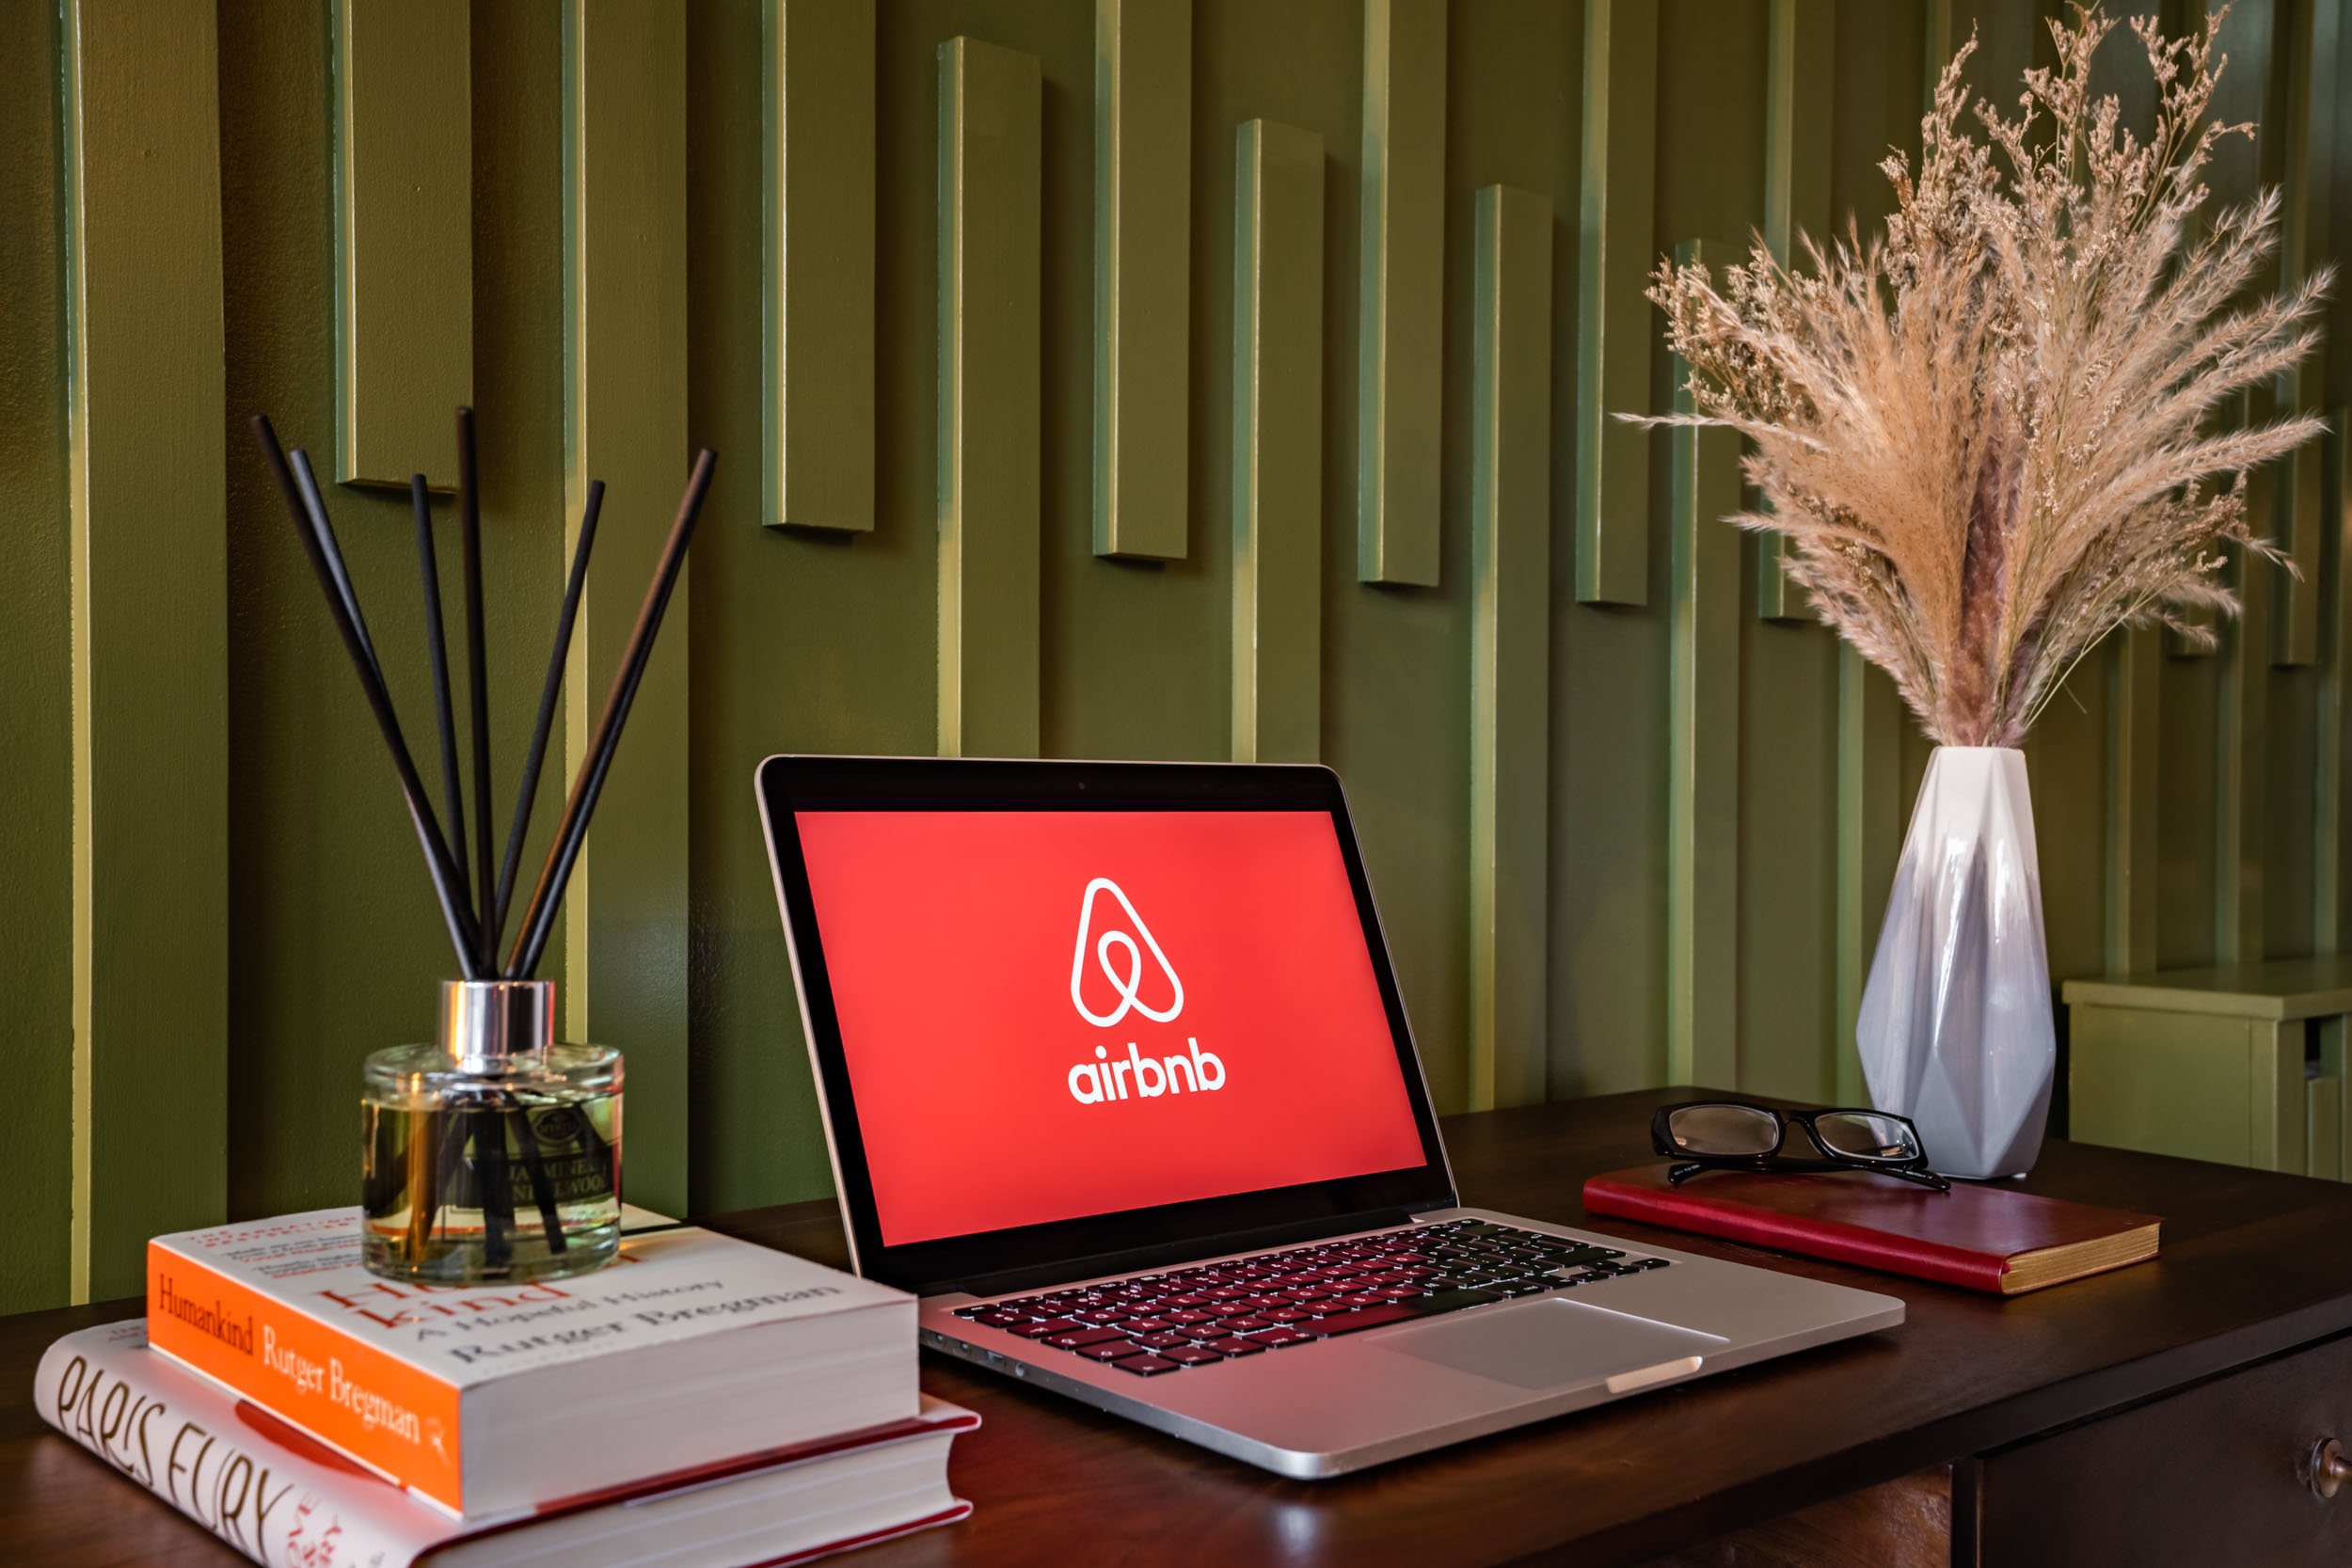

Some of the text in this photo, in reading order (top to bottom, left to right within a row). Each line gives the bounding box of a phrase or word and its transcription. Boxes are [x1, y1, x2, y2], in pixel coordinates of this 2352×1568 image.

[1068, 1037, 1226, 1104] airbnb
[354, 1280, 574, 1329] kind
[416, 1279, 724, 1342] A Hopeful History
[448, 1321, 626, 1364] Rutger
[632, 1285, 850, 1326] Bregman
[160, 1274, 421, 1445] Humankind Rutger Bregman
[57, 1355, 294, 1568] PARIS FURY
